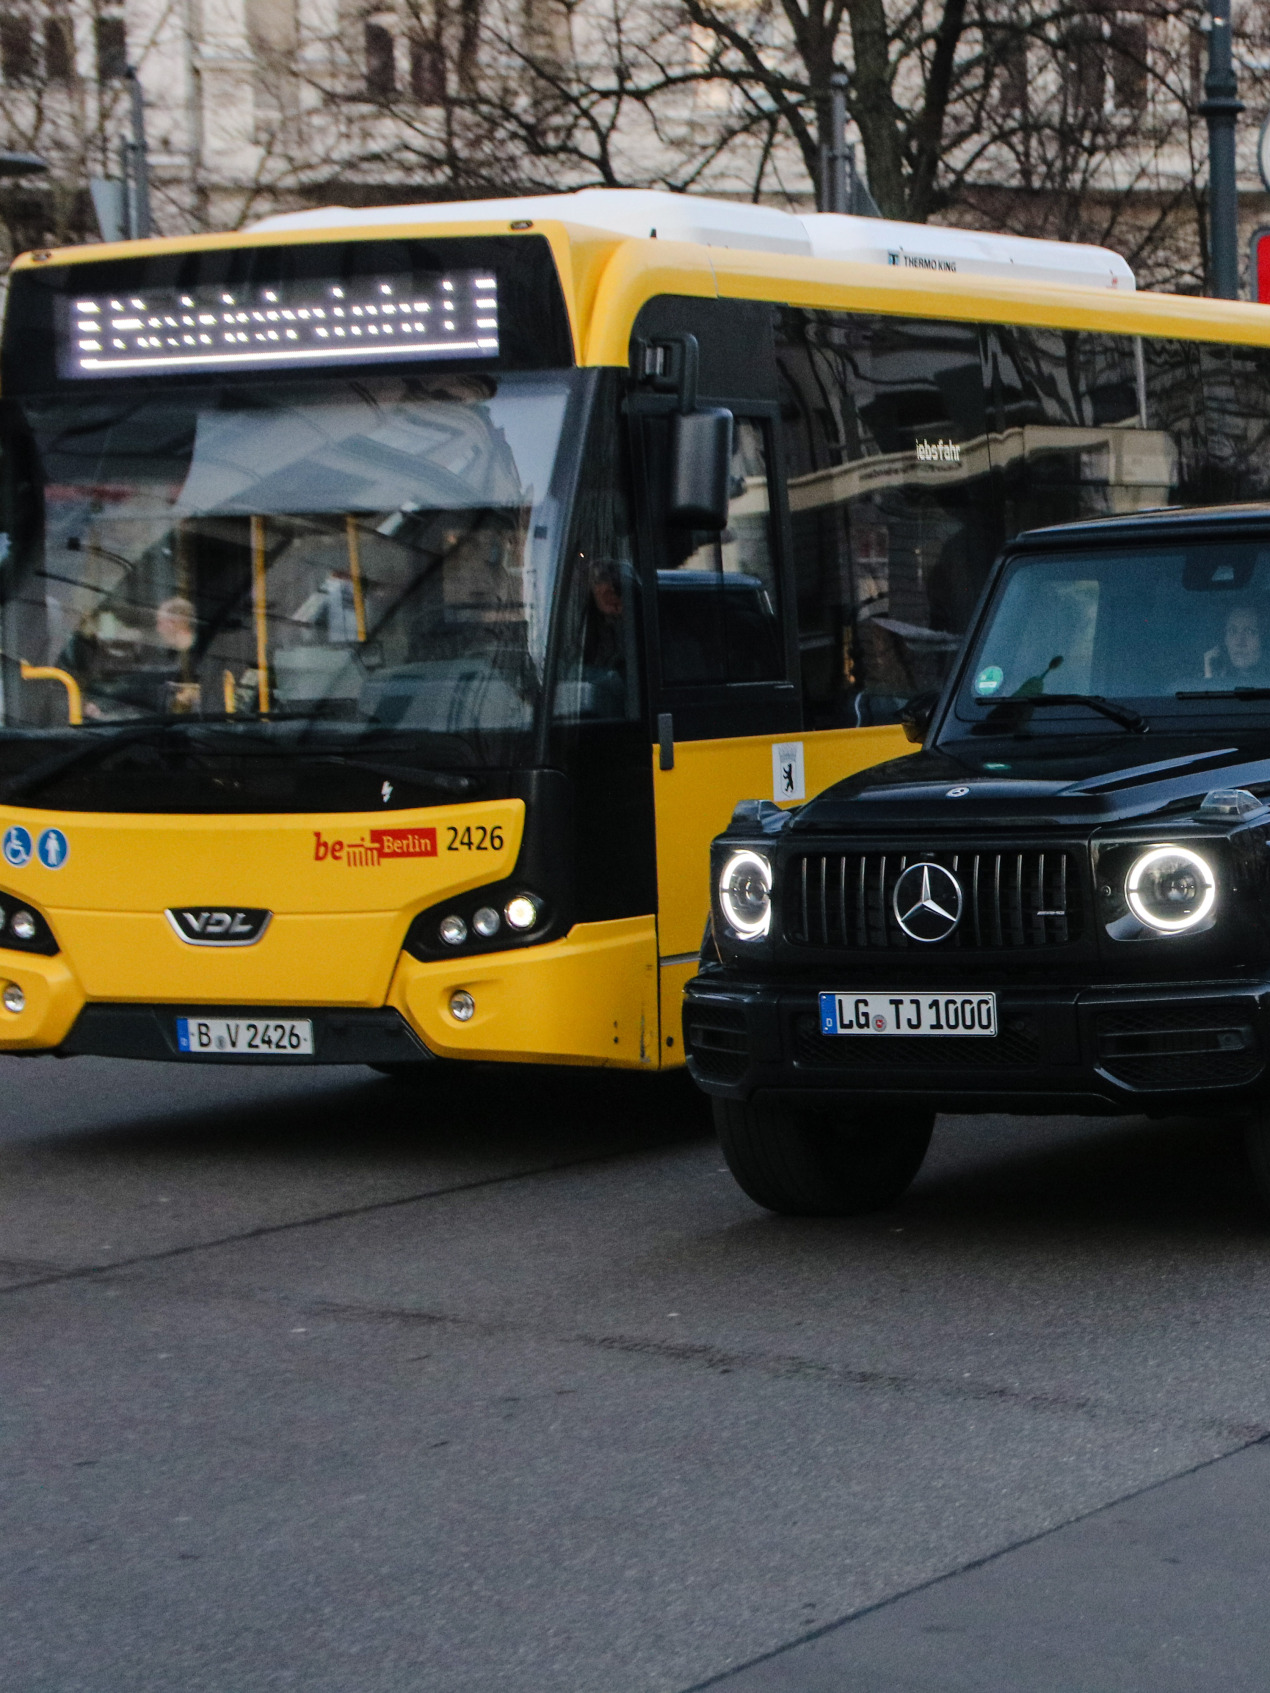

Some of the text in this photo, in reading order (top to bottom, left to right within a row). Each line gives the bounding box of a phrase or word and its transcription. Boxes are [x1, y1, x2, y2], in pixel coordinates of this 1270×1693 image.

[904, 255, 937, 270] THERMO
[938, 261, 957, 272] KING
[313, 831, 432, 861] be Berlin
[446, 826, 504, 851] 2426
[182, 911, 253, 933] VDL
[837, 998, 870, 1030] LG
[197, 1022, 301, 1050] B V 2426
